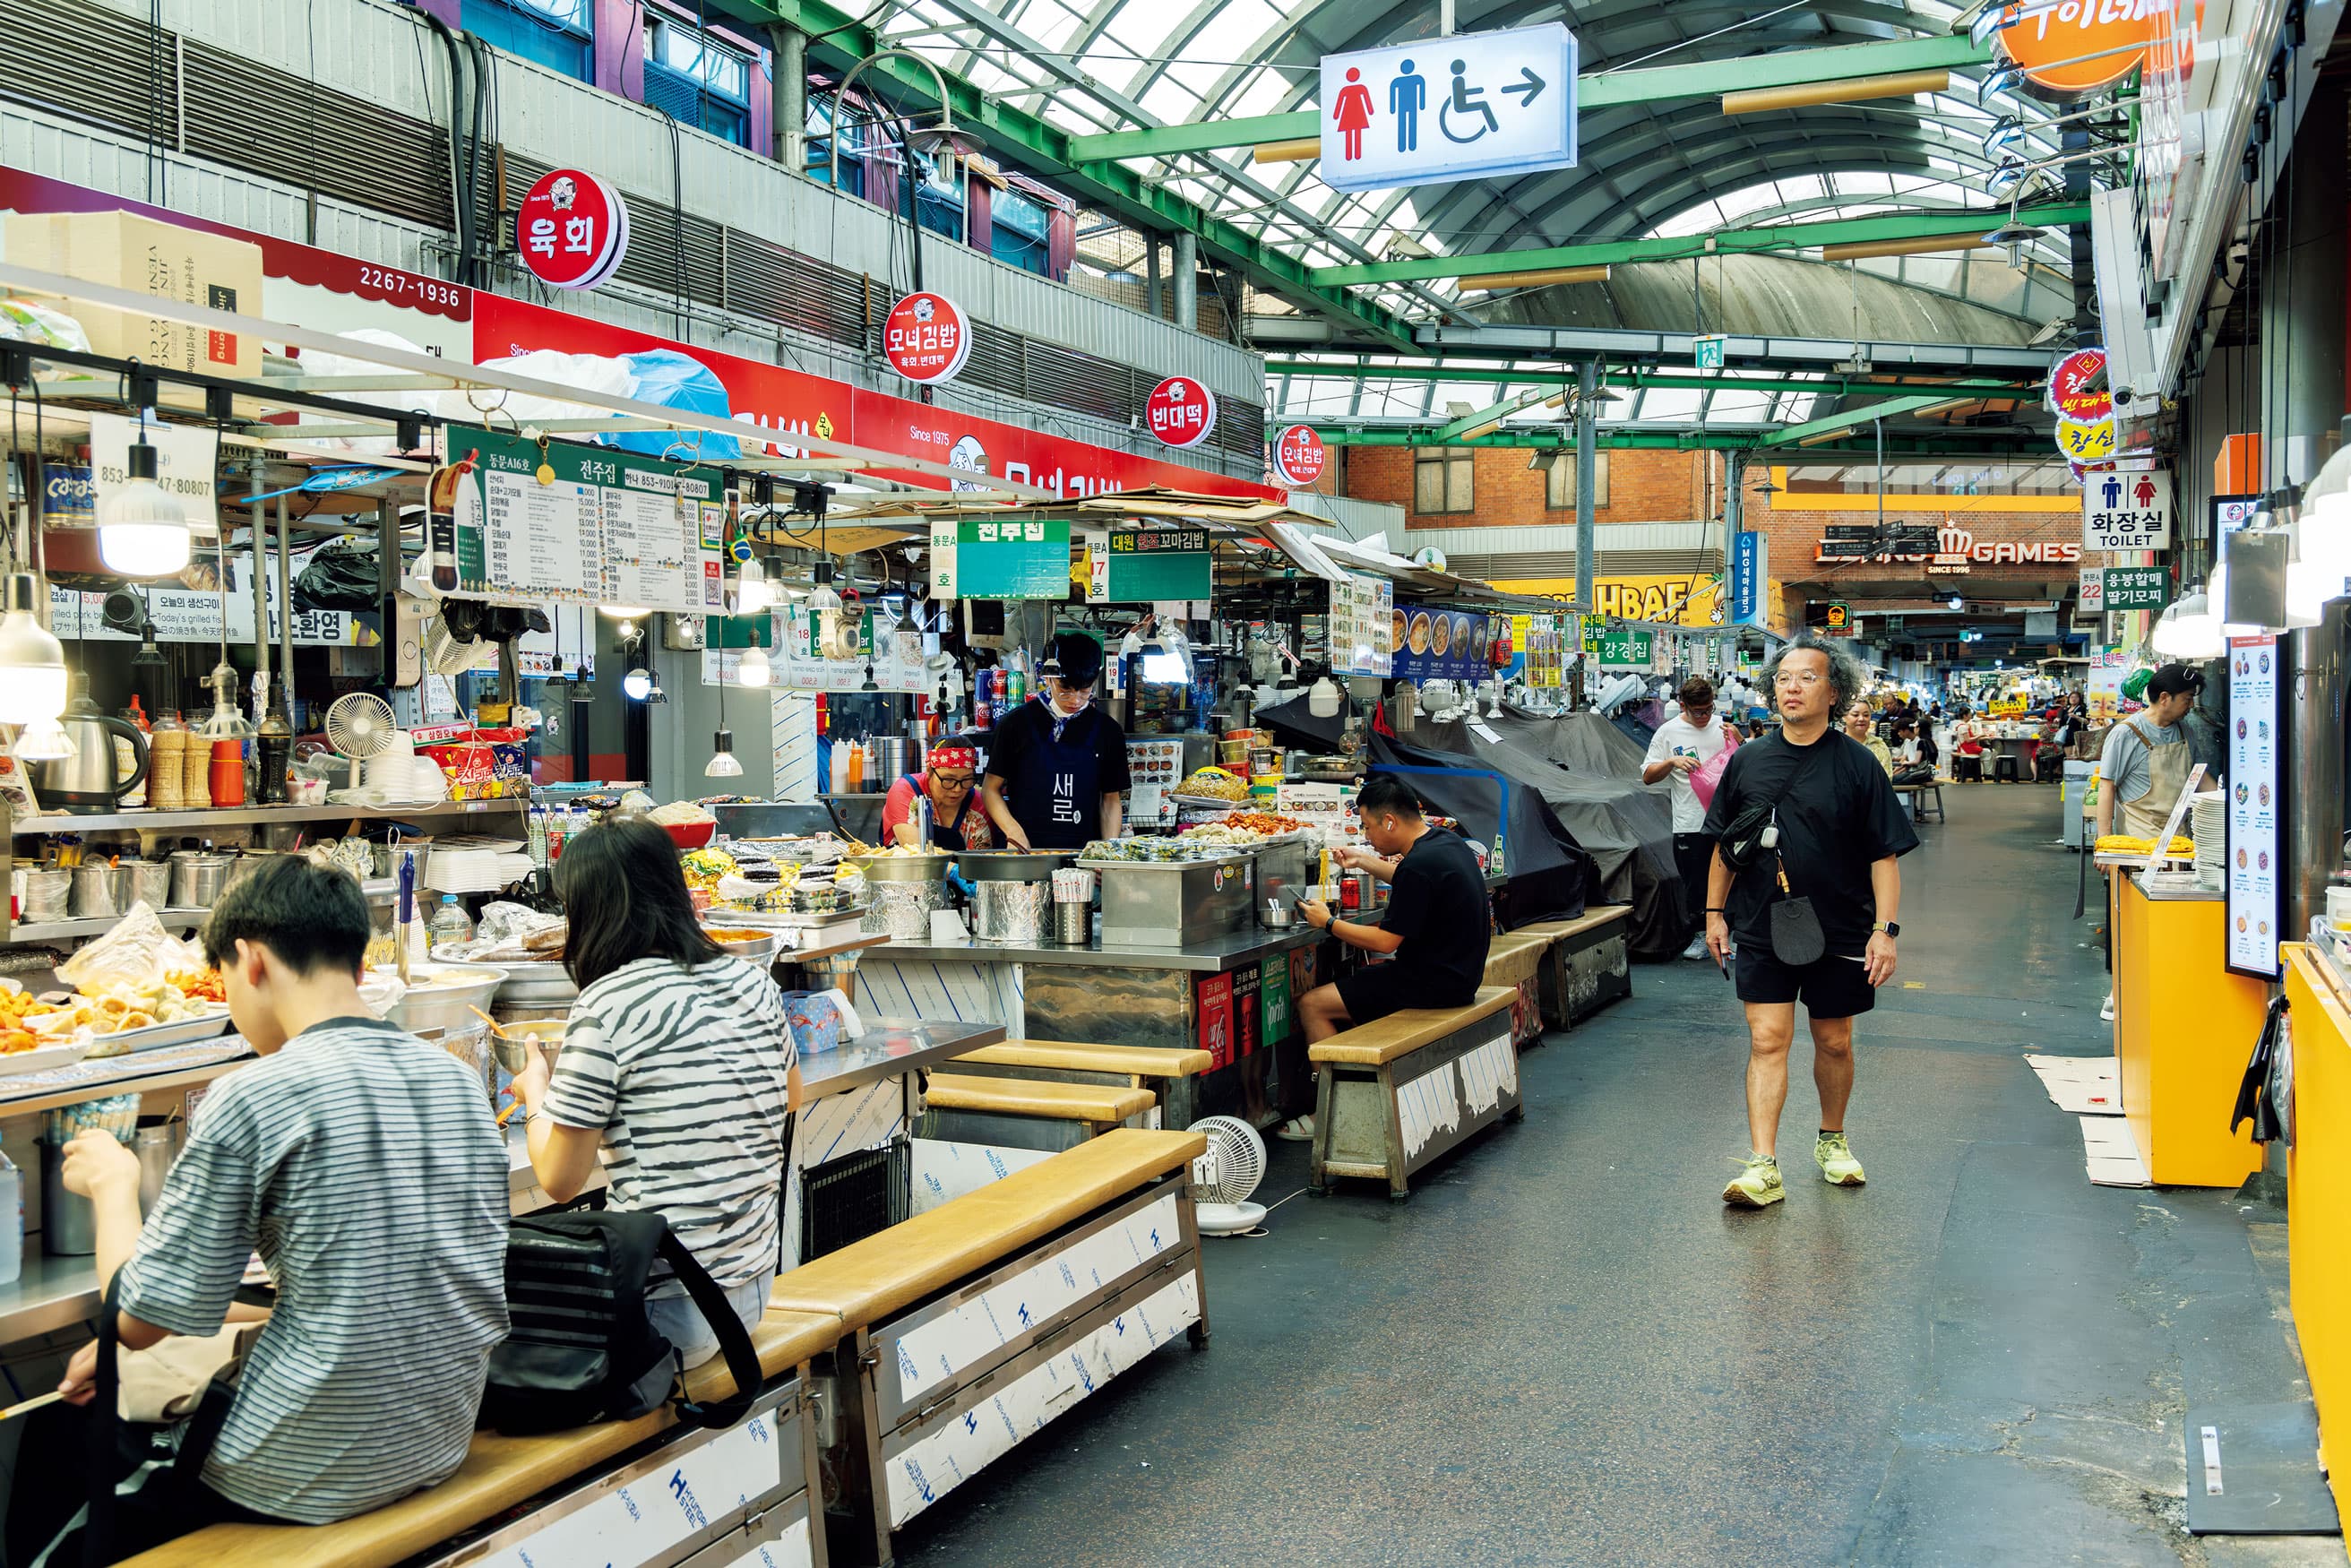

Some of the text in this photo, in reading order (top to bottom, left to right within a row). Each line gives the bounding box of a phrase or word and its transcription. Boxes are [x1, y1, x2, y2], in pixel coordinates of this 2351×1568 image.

[529, 216, 594, 259] 육회
[360, 266, 460, 307] 2267-1936
[1152, 403, 1202, 431] 빈대떡
[909, 425, 950, 446] Since 1975
[488, 453, 531, 472] 동문A16호
[580, 460, 616, 485] 전주집
[625, 473, 640, 483] 하나
[578, 498, 596, 507] 15,000
[2091, 511, 2163, 533] 화장실
[977, 522, 1045, 542] 전주집
[580, 539, 598, 547] 10,000
[933, 535, 957, 547] 동문A
[1112, 531, 1205, 552] 대원 원조 꼬마김밥
[2099, 535, 2153, 547] TOILET
[581, 549, 598, 558] 11,000
[1973, 542, 2082, 564] GAMES
[581, 560, 598, 569] 8,000
[1927, 565, 1970, 573] SINCE 1996
[582, 571, 599, 579] 8,000
[937, 573, 951, 587] 호
[2106, 572, 2163, 588] 응봉할매
[583, 581, 599, 590] 8,000
[2081, 584, 2101, 599] 22
[160, 595, 220, 610] 오늘의 생선구이
[1595, 582, 1689, 625] HBAF
[2106, 589, 2162, 605] 딸기모찌
[157, 613, 213, 626] Today's grilled
[693, 619, 704, 630] 17
[693, 633, 704, 644] 호
[797, 629, 810, 639] 18
[1584, 627, 1606, 639] 김밥
[2091, 656, 2102, 665] 23
[1108, 668, 1117, 677] 19
[1052, 772, 1074, 823] 새로
[898, 1345, 919, 1381] HYUNDAI
[678, 1496, 697, 1529] STEEL
[684, 1486, 708, 1528] HYUNDAI
